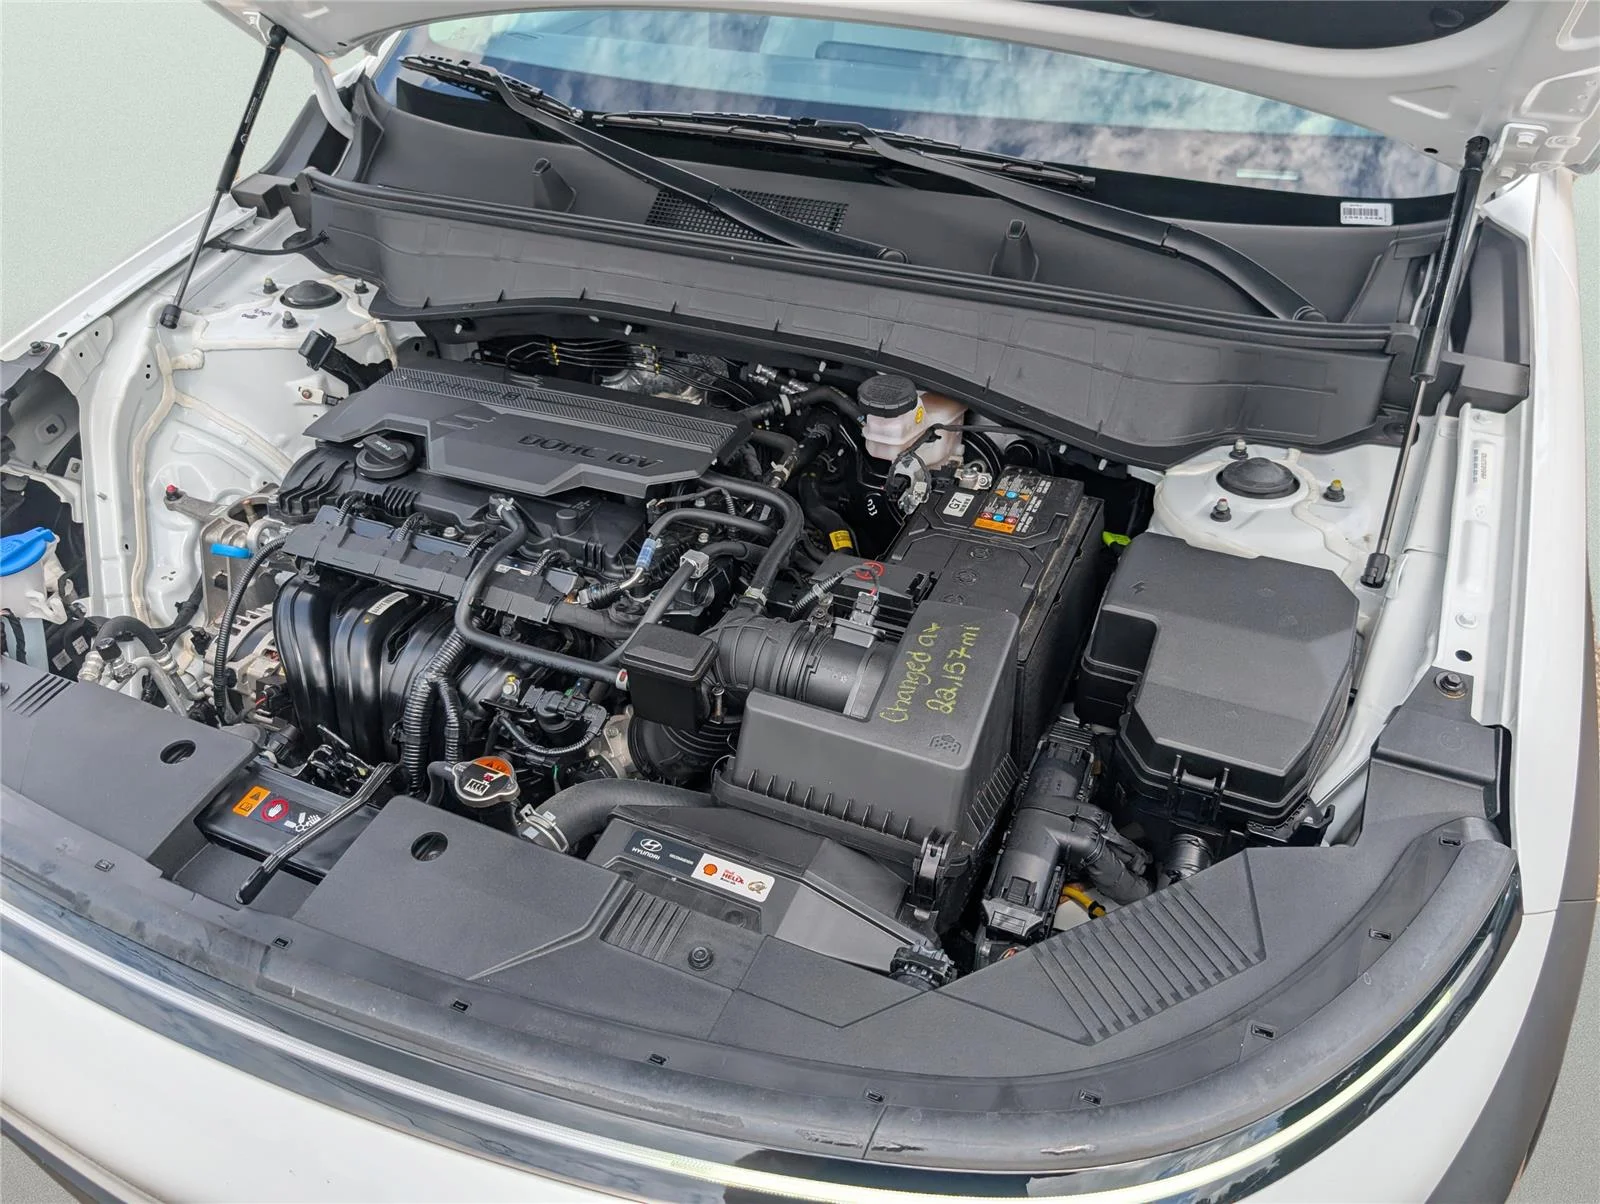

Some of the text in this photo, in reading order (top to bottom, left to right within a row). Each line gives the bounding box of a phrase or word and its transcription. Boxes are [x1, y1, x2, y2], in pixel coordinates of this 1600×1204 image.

[518, 433, 664, 469] DOHC 16V
[948, 498, 962, 510] G7
[879, 650, 933, 723] Changed
[631, 846, 661, 860] HYUNDAI
[721, 873, 745, 884] HELIX
